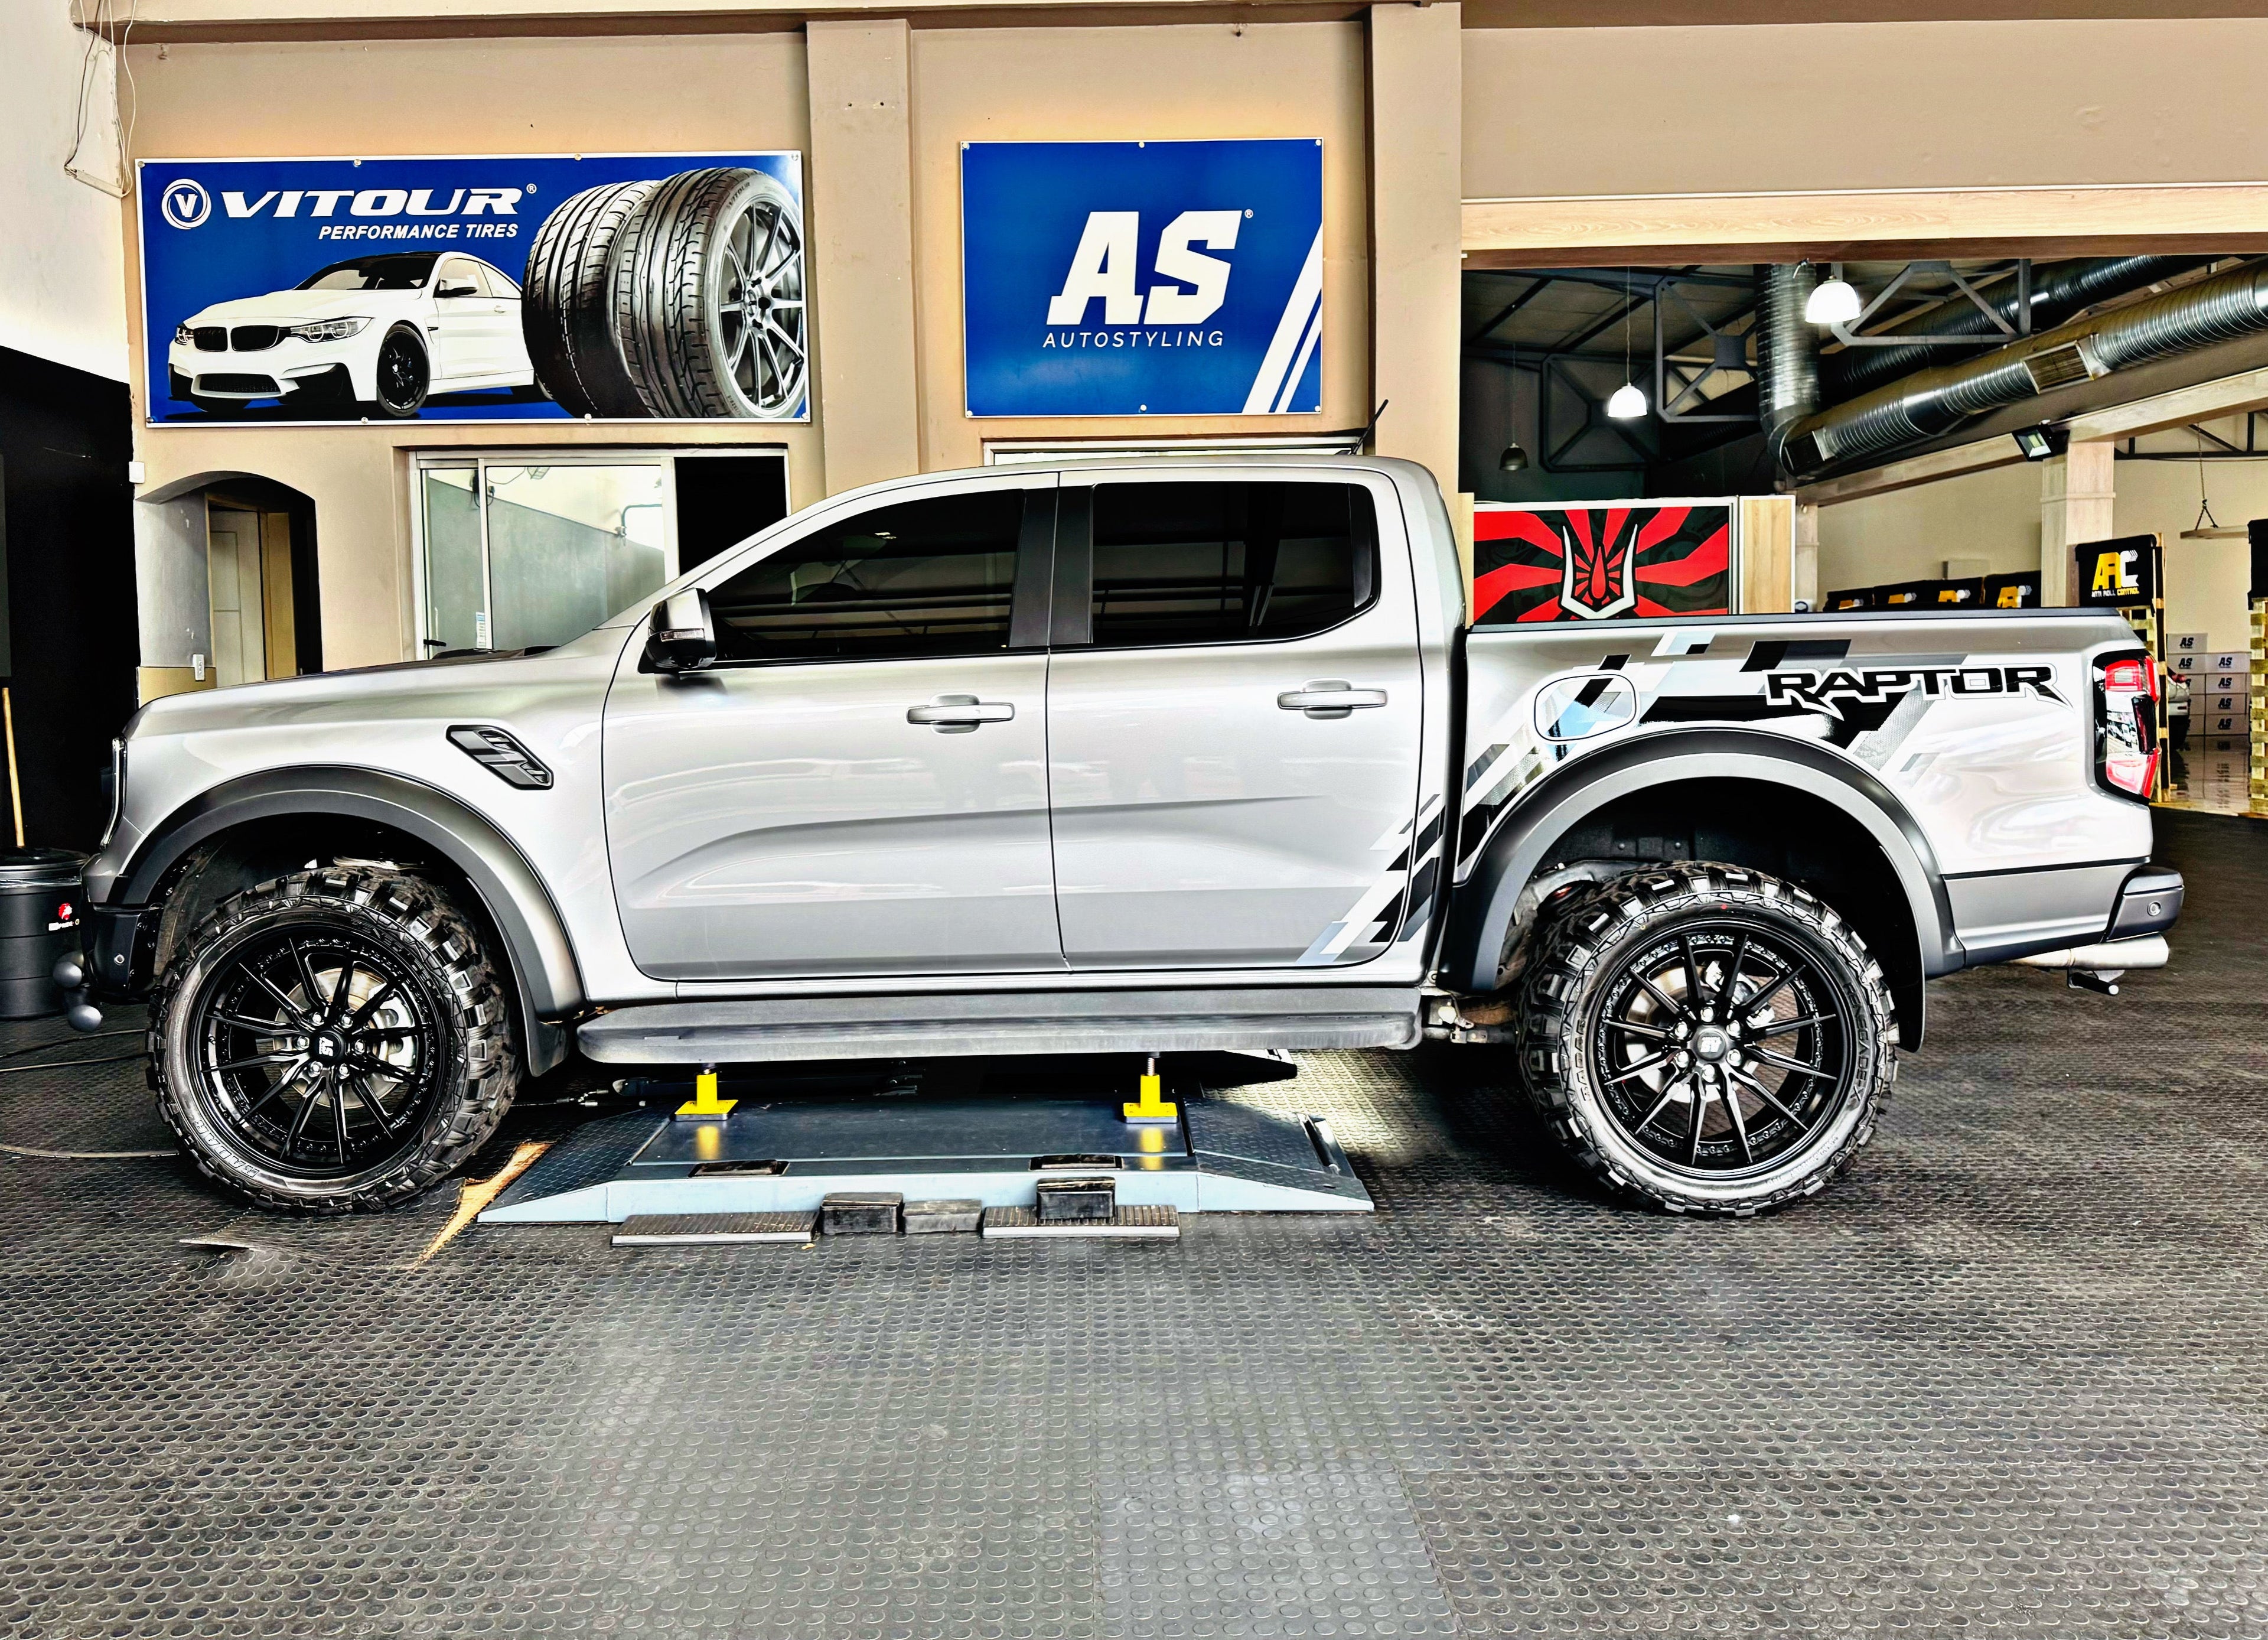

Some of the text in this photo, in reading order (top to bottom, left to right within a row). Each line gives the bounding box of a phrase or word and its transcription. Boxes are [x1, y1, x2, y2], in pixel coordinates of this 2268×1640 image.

[221, 187, 523, 218] VITOUR
[318, 223, 519, 240] PERFORMANCE TIRES
[1046, 210, 1243, 326] AS
[1042, 330, 1224, 348] AUTOSTYLING
[2179, 637, 2194, 647] AS
[2178, 658, 2193, 668] AS
[2218, 657, 2233, 666] AS
[2218, 678, 2233, 687] AS
[1763, 663, 2074, 720] RAPTOR
[2218, 698, 2232, 707] AS
